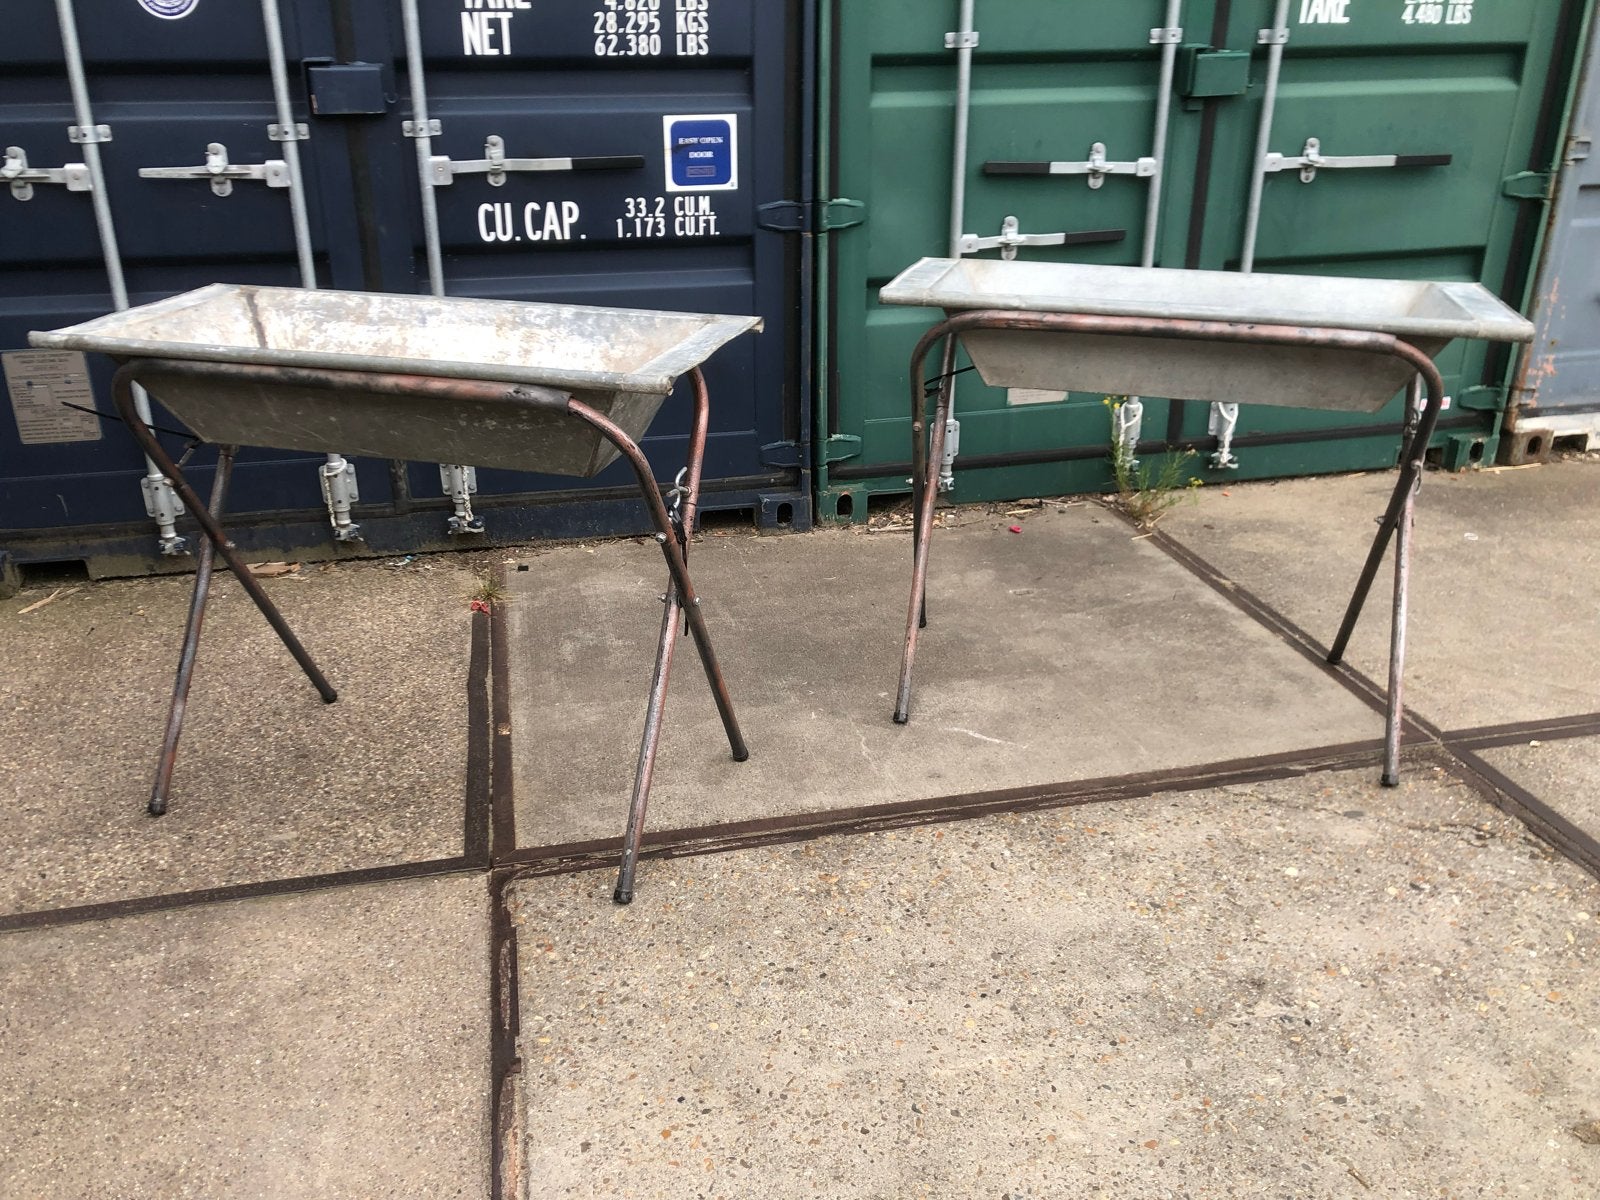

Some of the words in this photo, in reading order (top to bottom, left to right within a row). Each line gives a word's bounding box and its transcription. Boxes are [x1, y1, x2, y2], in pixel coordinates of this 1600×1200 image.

[461, 11, 514, 56] NET
[675, 11, 709, 34] KGS
[676, 33, 709, 56] LBS
[624, 196, 666, 218] 33.2
